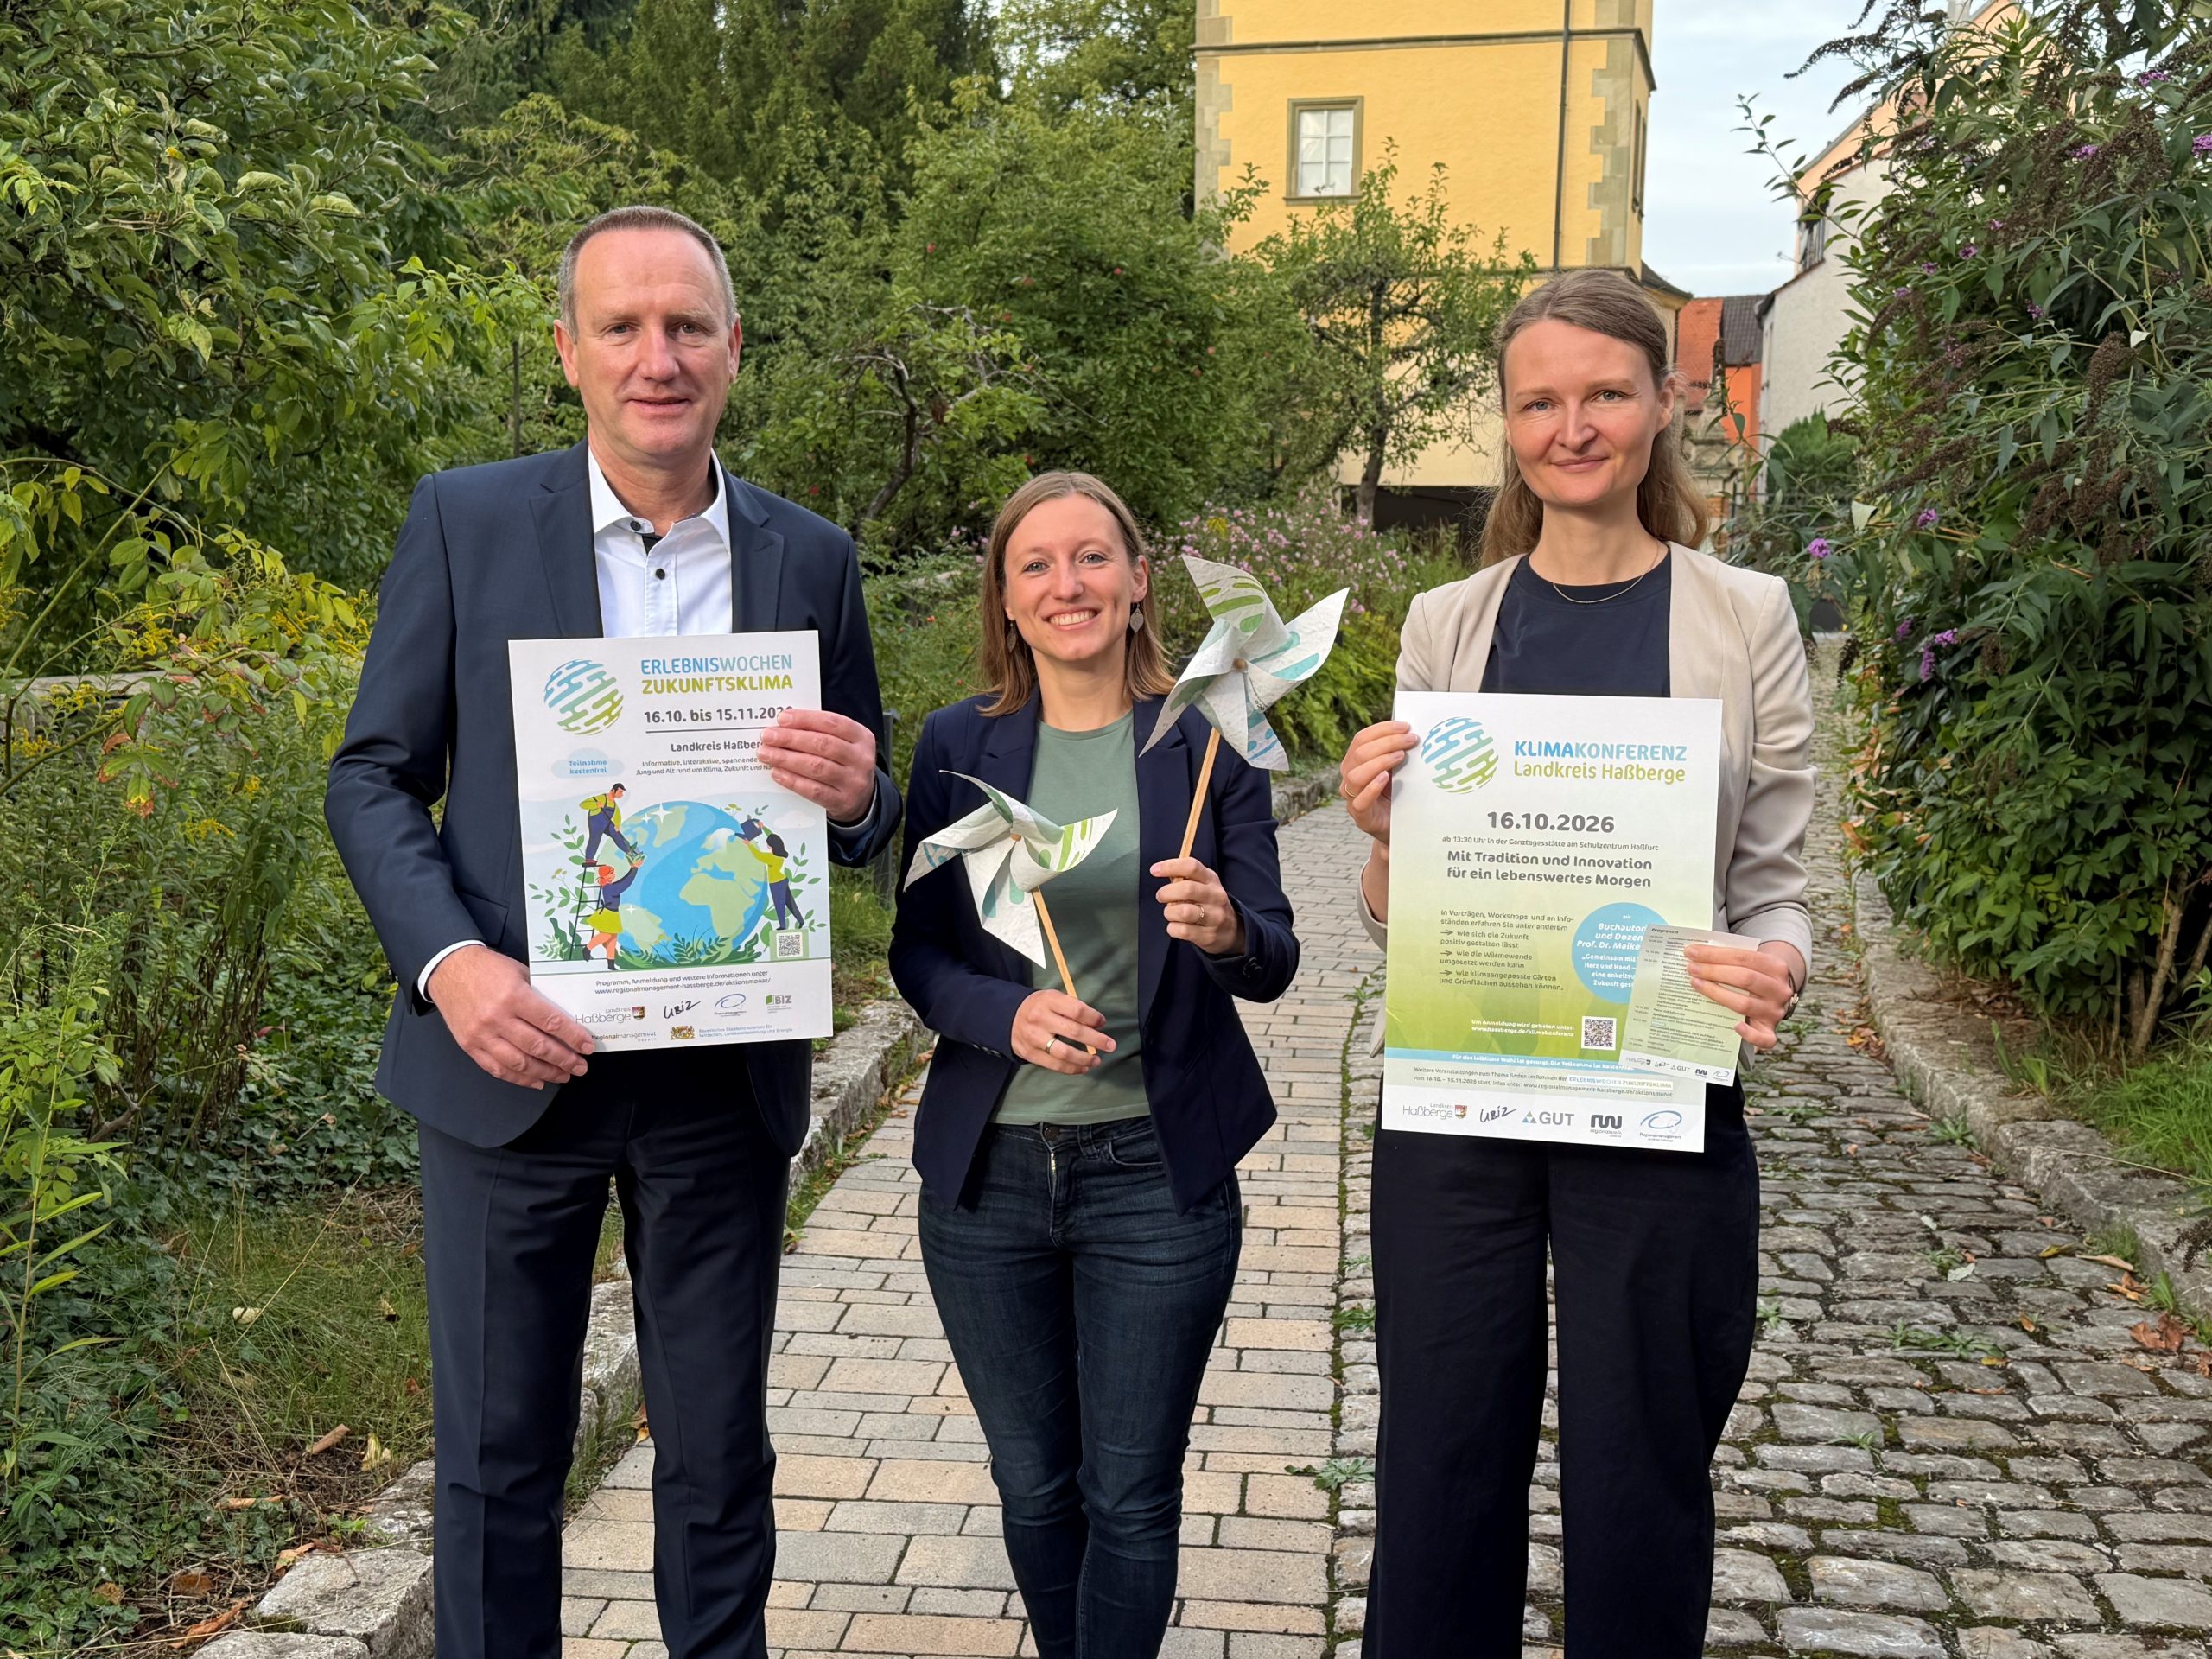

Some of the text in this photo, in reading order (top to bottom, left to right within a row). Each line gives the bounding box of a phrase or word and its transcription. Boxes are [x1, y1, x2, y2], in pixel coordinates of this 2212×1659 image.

[641, 654, 792, 675] ERLEBNISWOCHEN
[642, 674, 793, 695] ZUKUNFTSKLIMA
[645, 710, 687, 723] 16.10.
[690, 709, 712, 721] bis
[671, 741, 765, 752] Landkreis Haßber
[1515, 741, 1688, 761] KLIMAKONFERENZ
[1514, 760, 1686, 785] Landkreis Haßberge
[1487, 811, 1615, 833] 16.10.2026
[1453, 836, 1472, 844] 13:30
[1509, 838, 1566, 849] Ganztagesstätte
[1580, 841, 1630, 850] Schulzentrum
[1447, 850, 1652, 870] Mit Tradition und Innovation
[1447, 867, 1651, 888] für ein lebenswertes Morgen
[1449, 909, 1486, 918] Vorträgen,
[1487, 912, 1529, 921] Workshops
[1598, 923, 1649, 932] Buchautori
[1466, 939, 1501, 948] gestalten
[1614, 933, 1643, 942] Dozen
[1576, 939, 1597, 948] Prof.
[1612, 942, 1641, 950] Maike
[1484, 951, 1533, 961] Wärmewende
[1440, 958, 1478, 967] umgesetzt
[595, 979, 631, 988] Programm,
[632, 976, 669, 985] Anmeldung
[707, 971, 751, 980] Informationen
[1470, 970, 1531, 981] klimaangepasste
[1532, 973, 1557, 982] Gärten
[1454, 978, 1498, 988] Grünflächen
[575, 1012, 632, 1024] Haßberge
[1482, 1020, 1516, 1028] Anmeldung
[1402, 1105, 1453, 1120] Haßberge
[1539, 1111, 1575, 1126] GUT
